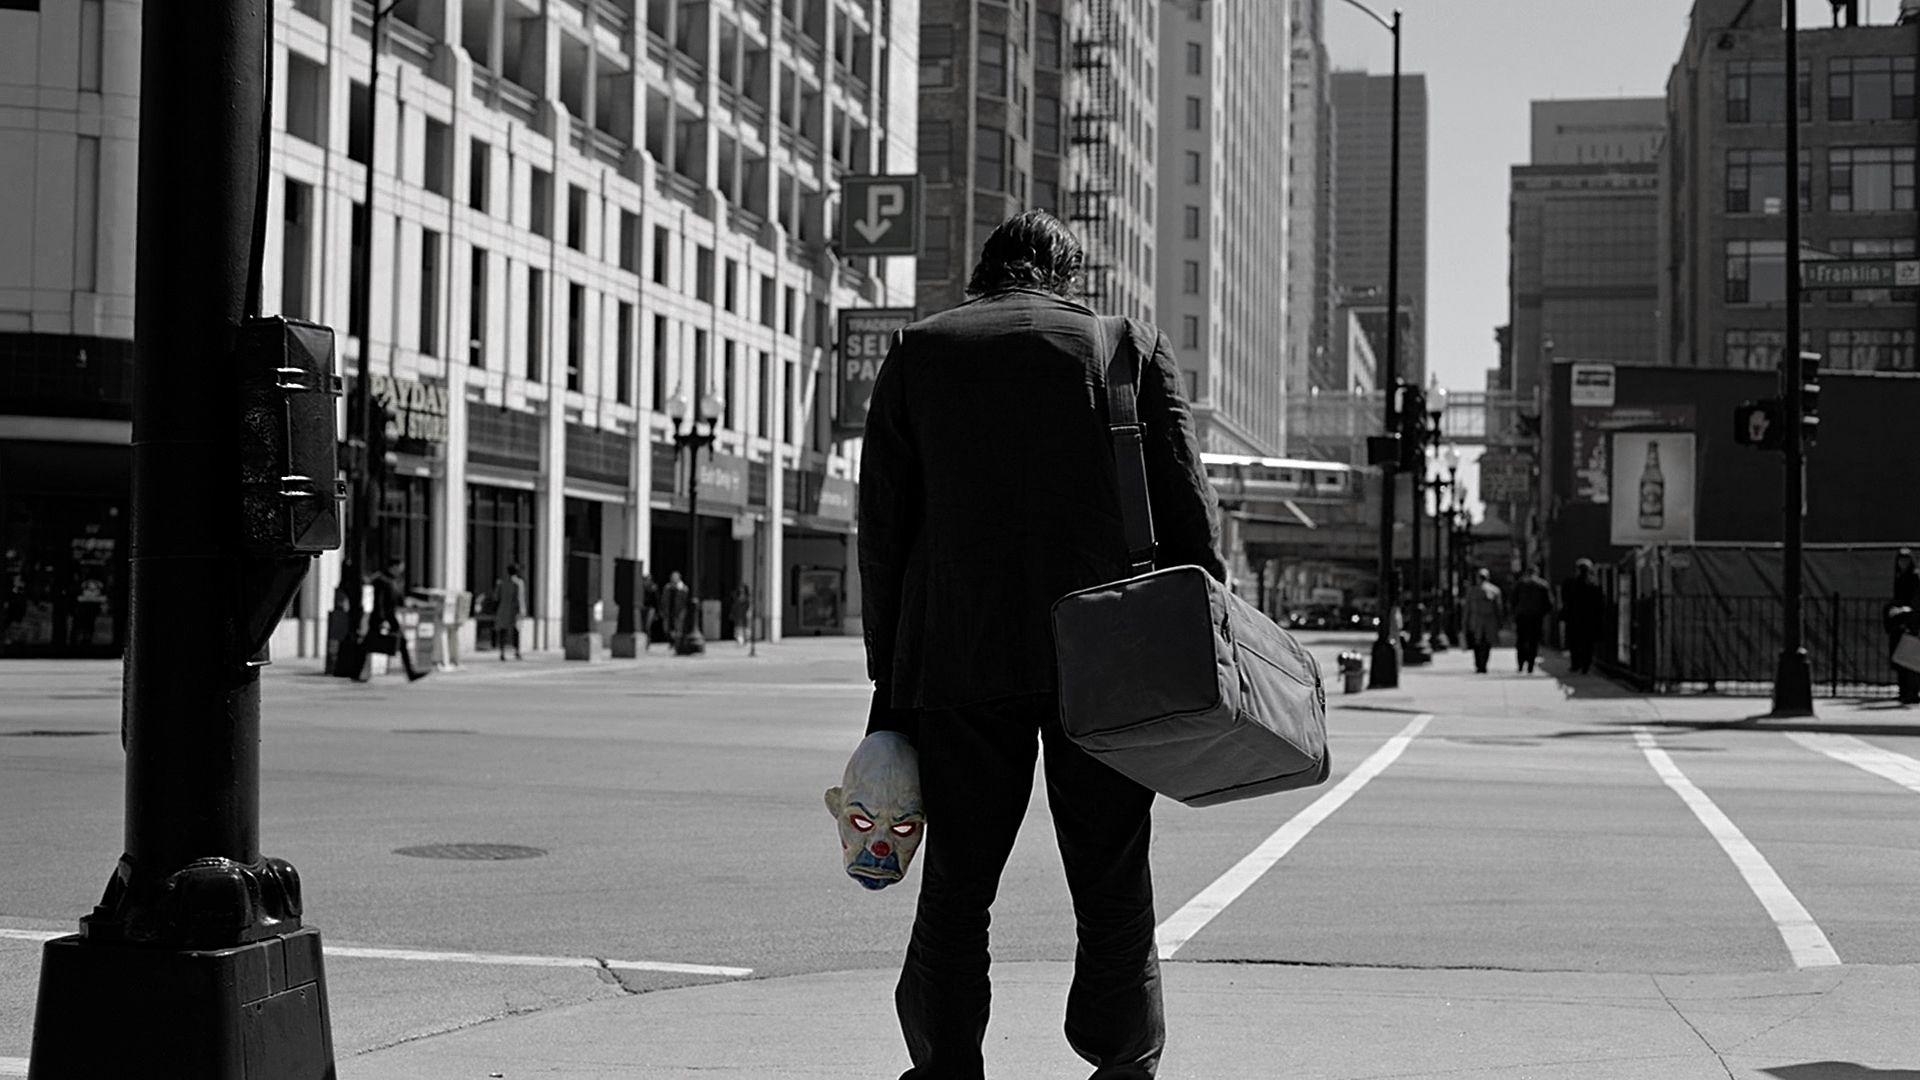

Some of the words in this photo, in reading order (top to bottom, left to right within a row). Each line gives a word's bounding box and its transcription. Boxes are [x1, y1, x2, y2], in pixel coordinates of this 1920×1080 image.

[866, 184, 904, 242] P
[1817, 264, 1880, 282] Franklin
[847, 334, 890, 356] SEL
[846, 359, 884, 381] PA
[370, 376, 448, 416] PAYDAY
